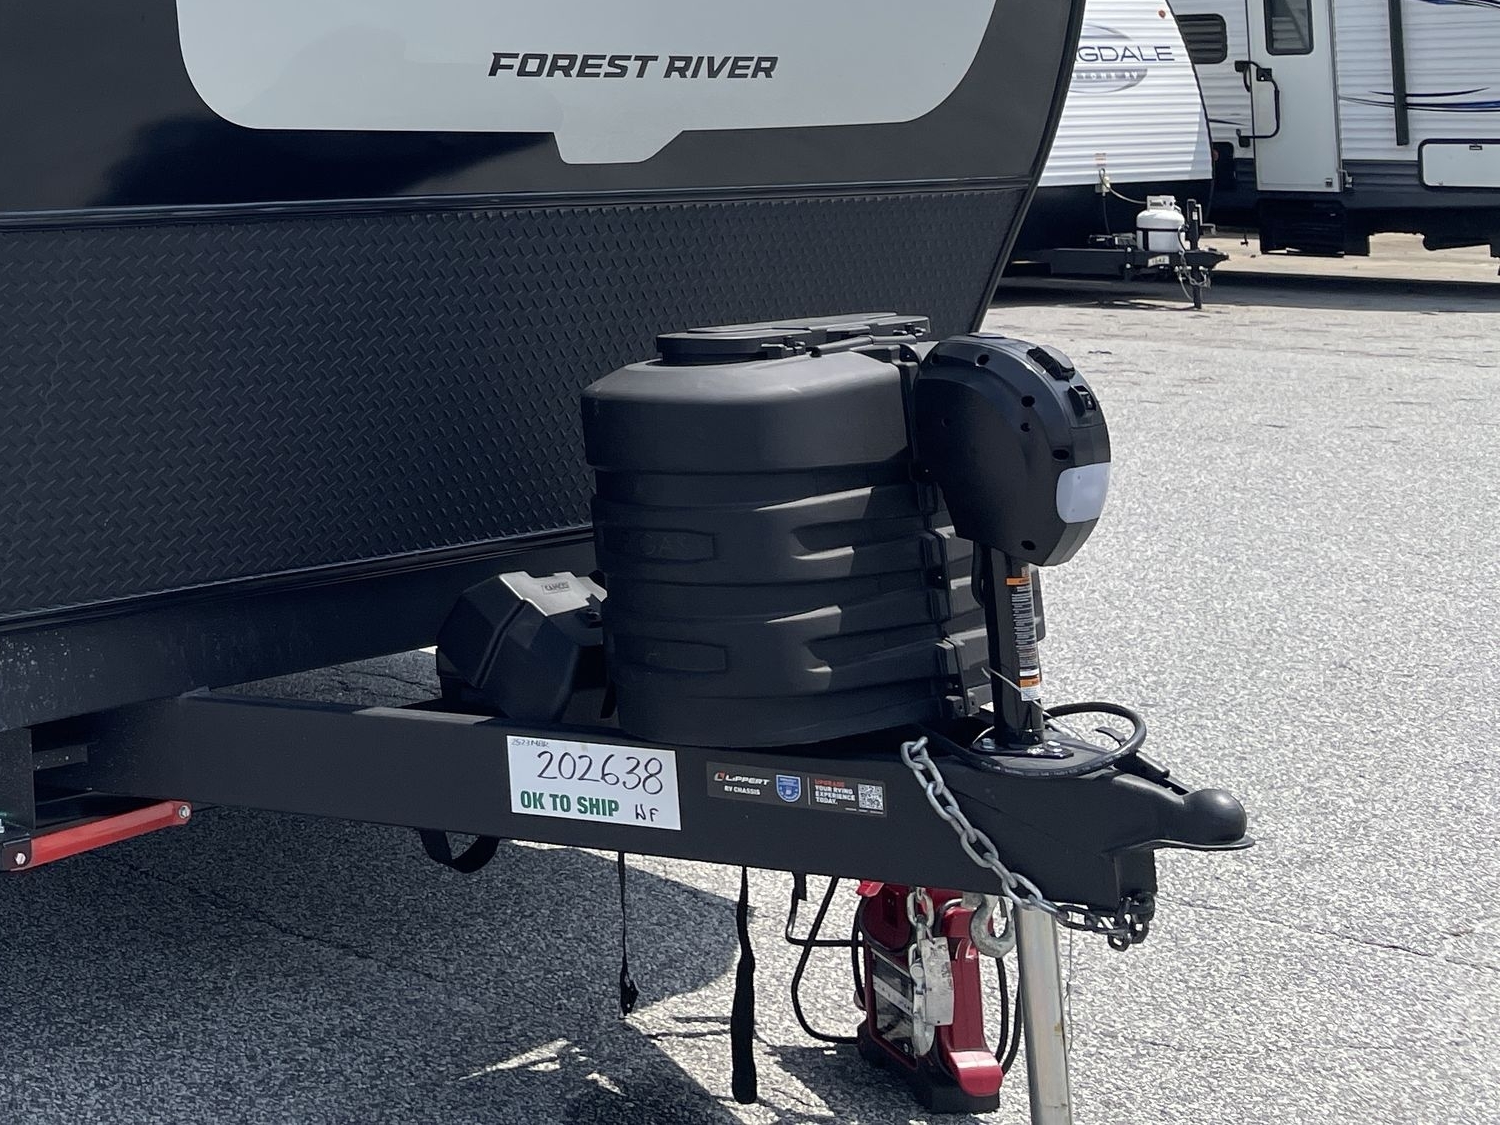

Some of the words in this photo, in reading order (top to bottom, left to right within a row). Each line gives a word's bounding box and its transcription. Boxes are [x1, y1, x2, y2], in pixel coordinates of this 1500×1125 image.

[1075, 46, 1175, 62] GDALE
[488, 52, 659, 78] FOREST
[663, 55, 779, 79] RIVER
[537, 751, 663, 795] 202638
[733, 786, 761, 796] CHASSIS
[815, 785, 833, 793] YOUR
[815, 790, 856, 801] EXPERIENCE
[520, 790, 546, 810] OK
[549, 793, 572, 813] TO
[577, 795, 620, 817] SHIP
